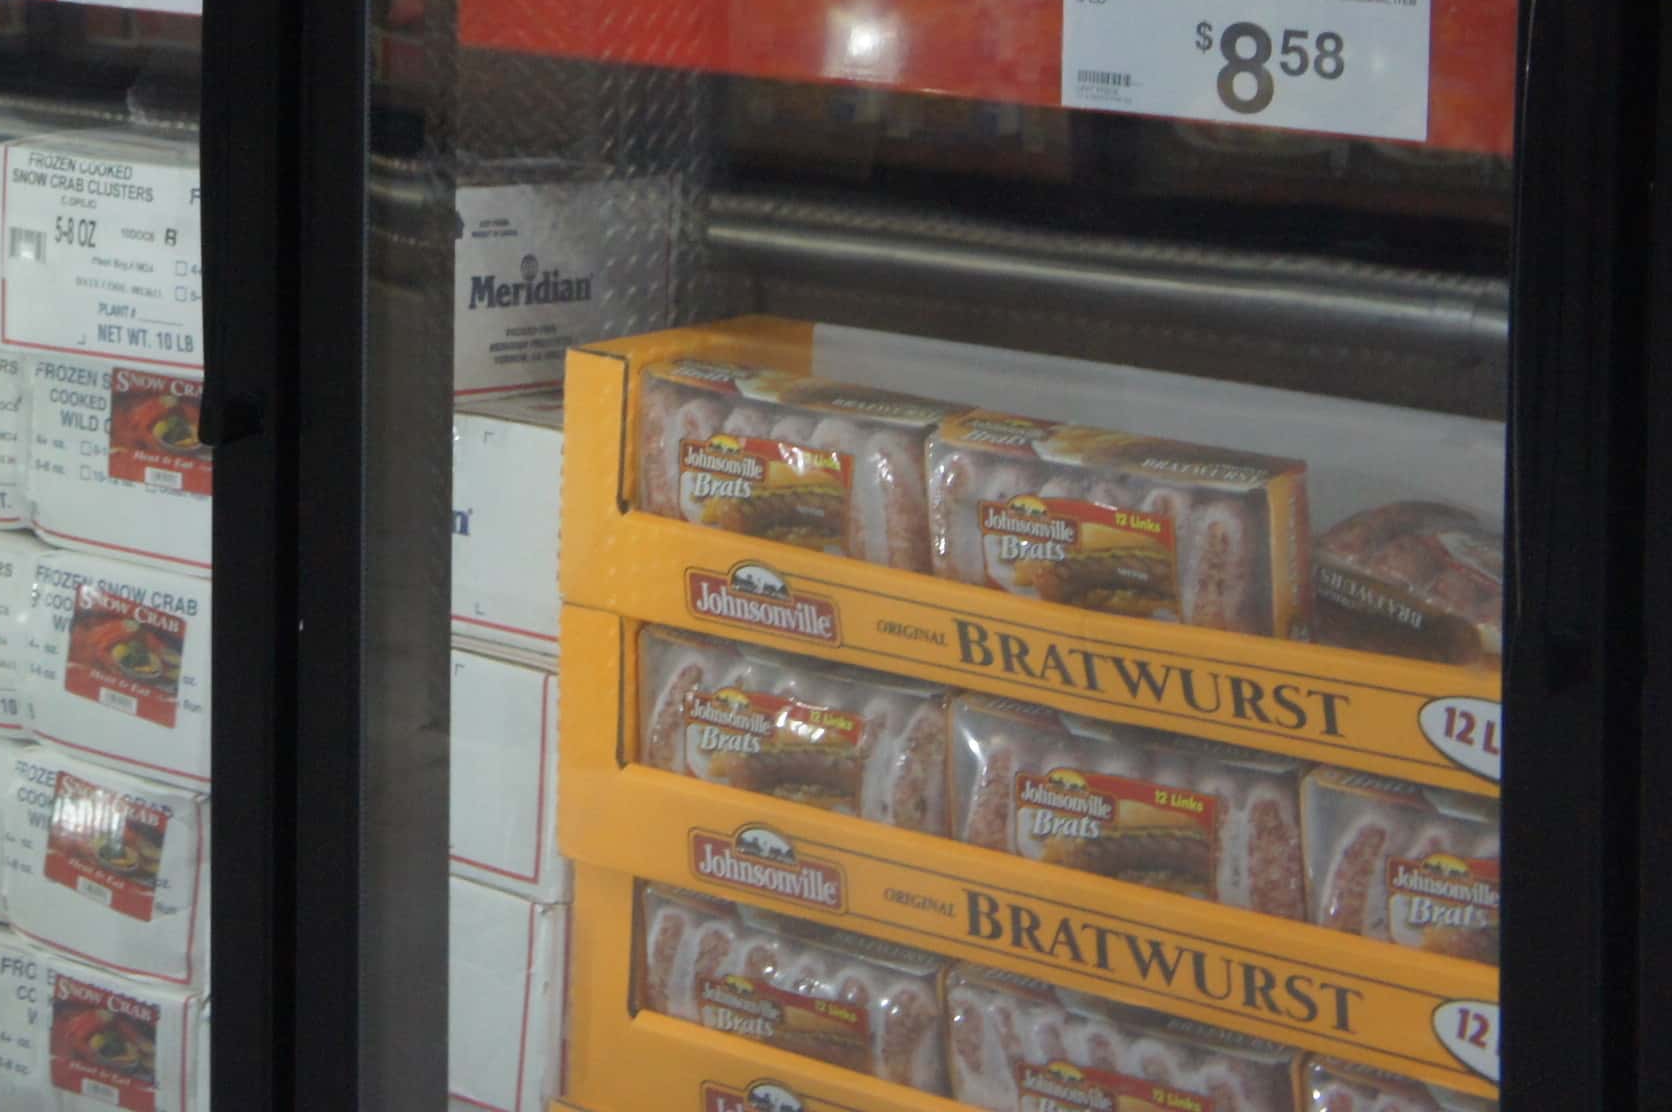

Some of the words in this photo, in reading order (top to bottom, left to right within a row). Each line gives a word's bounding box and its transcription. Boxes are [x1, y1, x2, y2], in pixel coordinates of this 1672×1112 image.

[28, 152, 76, 173] FROZEN
[79, 159, 133, 180] COOKED
[12, 167, 47, 187] SNOW
[50, 174, 85, 195] CRAB
[87, 180, 155, 204] CLUSTERS
[79, 218, 98, 248] OZ
[468, 267, 594, 310] Meridian
[98, 302, 129, 319] PLANT
[97, 324, 123, 344] NET
[156, 331, 173, 351] 10
[177, 332, 195, 353] LB
[35, 361, 98, 388] FROZEN
[116, 370, 168, 394] SNOW
[50, 388, 108, 411] COOKED
[60, 409, 100, 433] WILD
[684, 446, 764, 480] Johnsonville
[695, 471, 752, 500] Brats
[984, 509, 1075, 543] Johnsonville
[1114, 512, 1128, 527] 12
[1130, 513, 1162, 533] Links
[999, 536, 1066, 562] Brats
[151, 591, 199, 617] CRAB
[696, 582, 833, 638] Johnsonville
[134, 606, 180, 634] CRAB
[877, 619, 948, 647] ORIGINAL
[952, 617, 1349, 738] BRATWURST
[691, 699, 772, 735] Johnsonville
[823, 714, 855, 731] Links
[1443, 705, 1477, 745] 12
[701, 726, 761, 754] Brats
[1019, 779, 1114, 819] Johnsonville
[1154, 788, 1169, 808] 12
[1170, 792, 1205, 815] Links
[1031, 807, 1101, 840] Brats
[700, 843, 838, 905] Johnsonville
[883, 887, 956, 918] ORIGINAL
[1406, 893, 1490, 929] Brats
[961, 888, 1365, 1035] BRATWURST
[106, 995, 154, 1024] CRAB
[713, 1008, 775, 1038] Brats
[1455, 1007, 1490, 1051] 12
